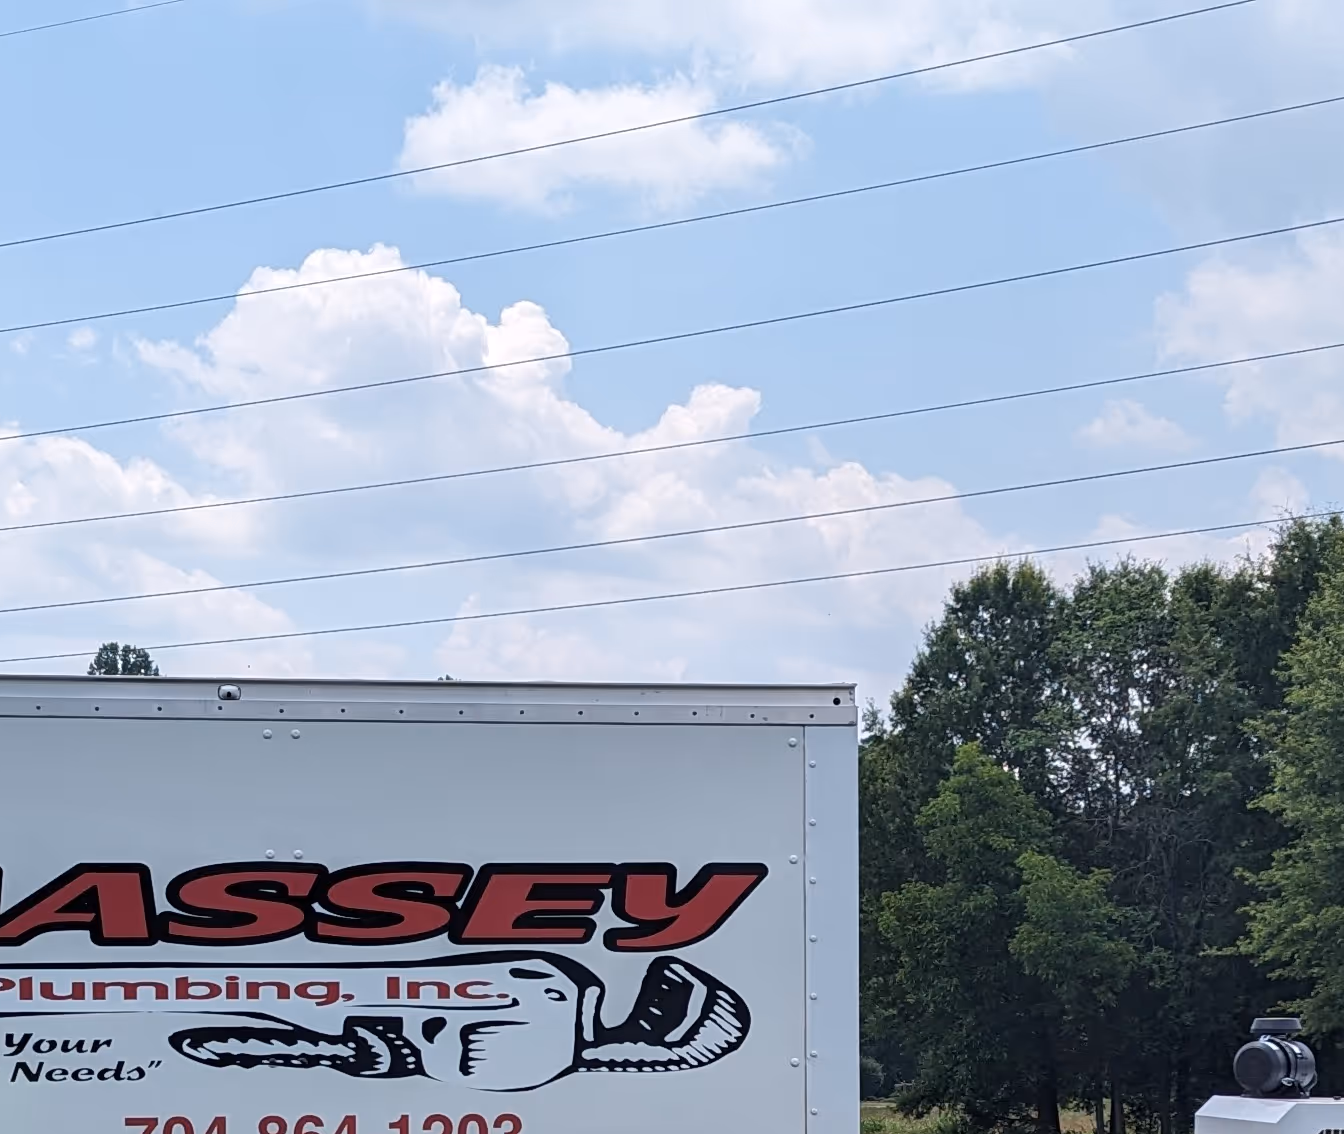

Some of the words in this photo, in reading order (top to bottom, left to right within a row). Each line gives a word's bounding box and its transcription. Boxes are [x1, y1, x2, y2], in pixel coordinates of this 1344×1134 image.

[385, 975, 510, 1000] Inc.
[3, 1032, 113, 1056] Your
[10, 1060, 162, 1084] Needs”
